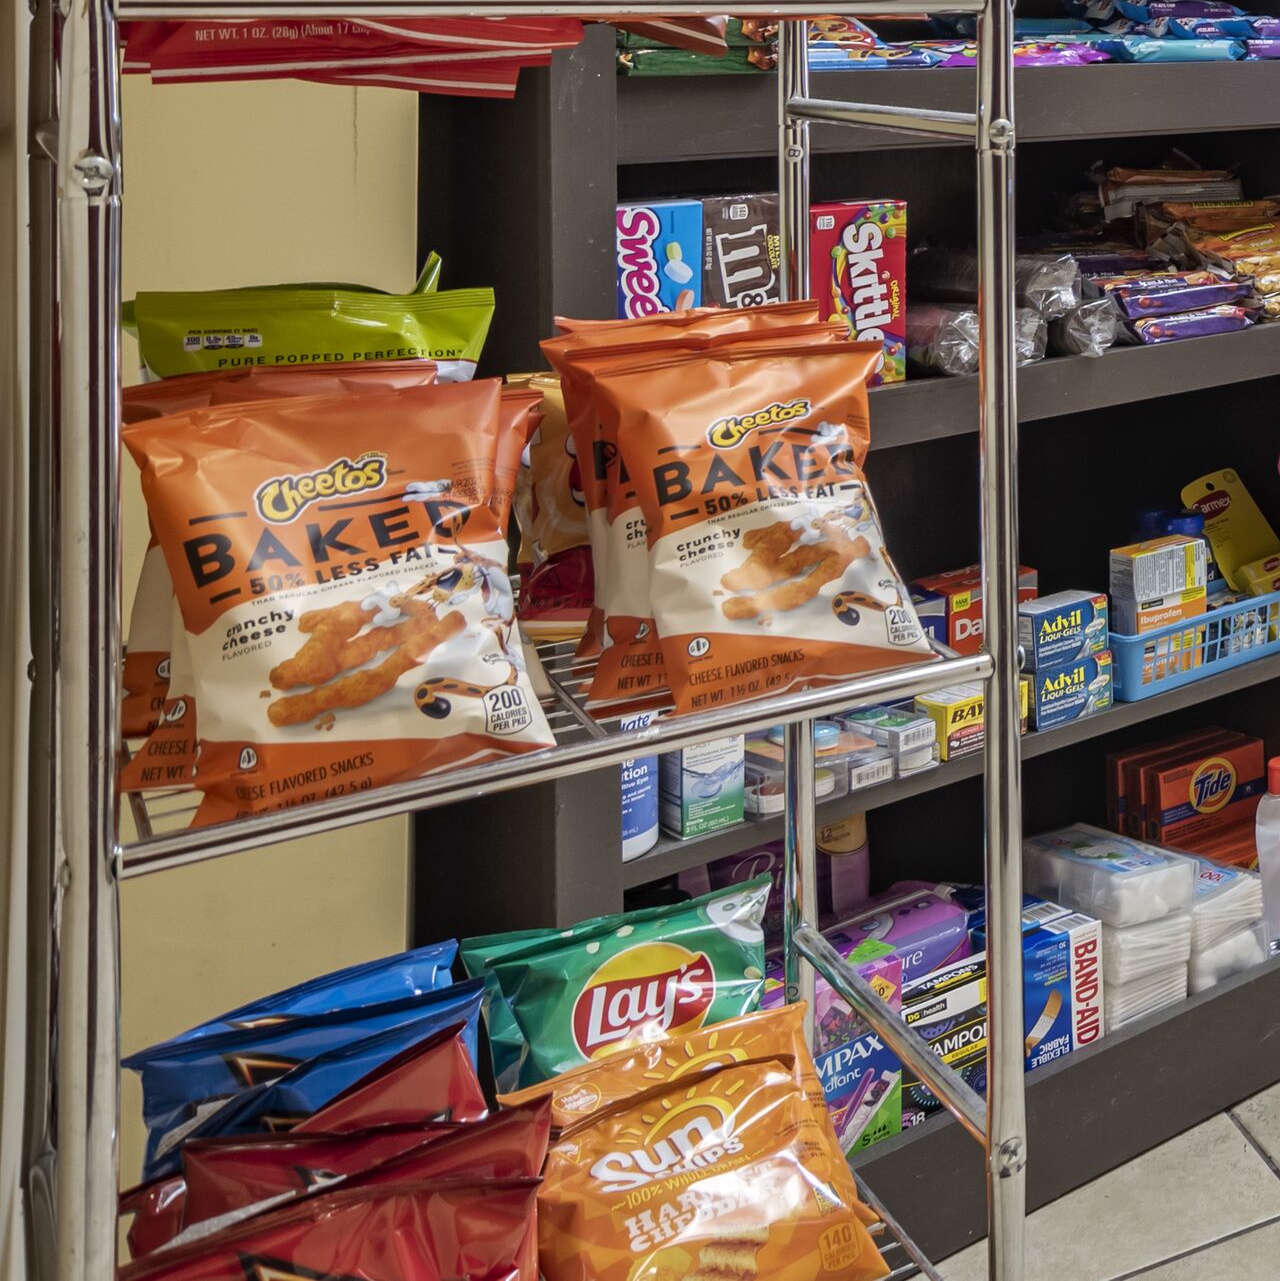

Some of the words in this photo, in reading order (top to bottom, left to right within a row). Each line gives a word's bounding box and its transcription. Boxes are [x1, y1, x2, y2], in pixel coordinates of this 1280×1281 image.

[195, 29, 215, 42] NET
[219, 27, 240, 41] WT.
[243, 27, 248, 39] 1
[252, 26, 269, 39] OZ.
[272, 25, 298, 41] (28g)
[301, 22, 335, 40] (About
[337, 23, 349, 36] 17
[218, 355, 266, 368] PURE
[275, 351, 344, 365] POPPED
[352, 348, 457, 362] PERFECTION
[708, 400, 811, 448] Cheetos
[652, 443, 855, 507] BAKED
[257, 460, 387, 522] Cheetos
[184, 500, 472, 589] BAKED
[677, 527, 741, 554] crunchy
[250, 573, 306, 596] 50%
[318, 558, 381, 587] LESS
[390, 543, 435, 565] FAT
[226, 608, 295, 638] crunchy
[1039, 609, 1082, 636] Advil
[1140, 608, 1182, 624] Ibuprofen
[222, 624, 286, 652] cheese
[1040, 626, 1082, 644] LIQUI-GELS
[688, 665, 723, 687] CHEESE
[725, 656, 769, 678] FLAVORED
[771, 649, 805, 667] SNACKS
[1041, 666, 1086, 695] Advil
[491, 688, 522, 713] 200
[1042, 682, 1085, 702] LIQUI-GELS
[490, 707, 528, 723] CALORIES
[492, 721, 511, 733] PER
[512, 718, 528, 730] PKG
[269, 766, 328, 795] FLAVORED
[331, 752, 374, 777] SNACKS
[1193, 768, 1232, 807] Tide
[918, 964, 978, 991] TAMPONS
[586, 962, 706, 1048] Lay's
[1075, 939, 1100, 1045] BAND-AID
[907, 1012, 920, 1023] DG
[923, 1001, 946, 1016] health
[951, 1043, 978, 1059] REGULAR
[1032, 1044, 1070, 1068] FLEXIBLE
[1040, 1034, 1069, 1054] FABRIC
[910, 1112, 925, 1126] 18
[589, 1113, 714, 1193] Sun
[822, 1229, 853, 1250] 140
